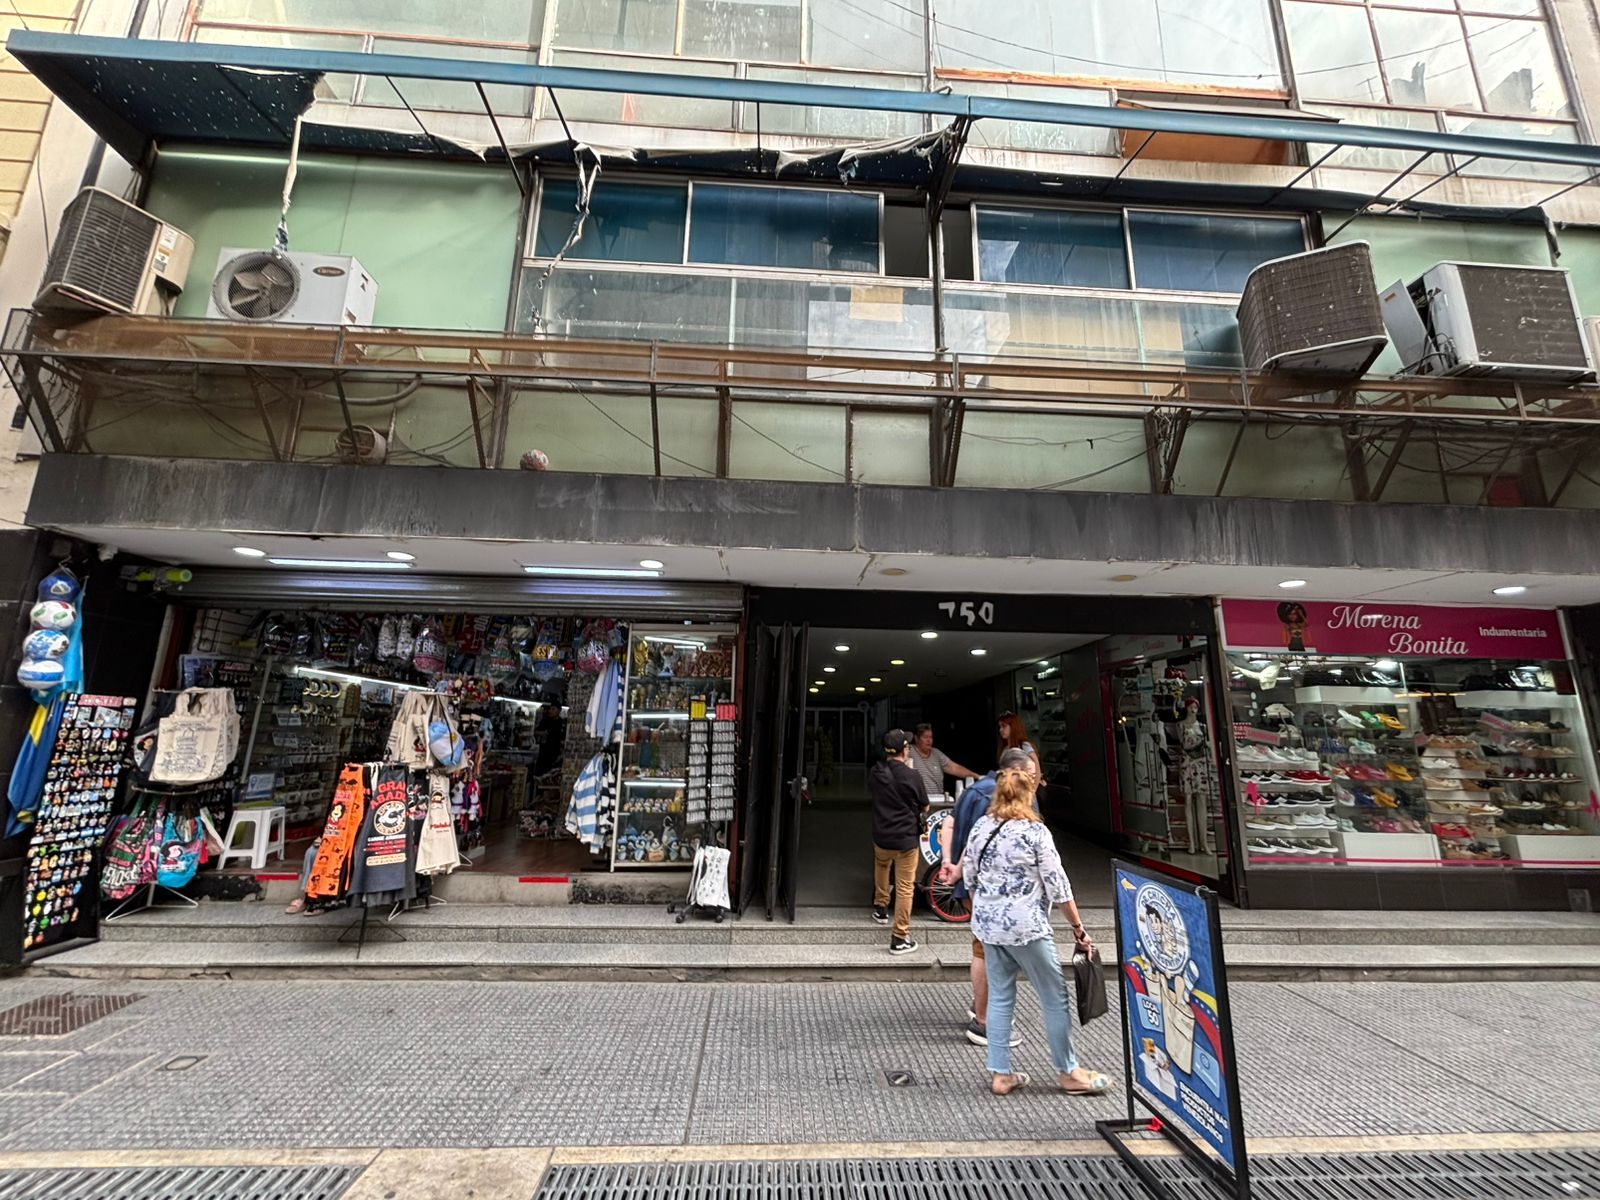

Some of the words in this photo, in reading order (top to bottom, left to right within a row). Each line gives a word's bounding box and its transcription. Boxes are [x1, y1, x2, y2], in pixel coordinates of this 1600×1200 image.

[938, 601, 994, 626] 750
[1327, 605, 1421, 630] Morena
[1387, 632, 1469, 655] Bonita
[1478, 626, 1548, 638] Indumentaria
[925, 850, 936, 862] EN
[1142, 999, 1159, 1013] LOCAL
[1147, 1009, 1159, 1026] 50
[1180, 1091, 1215, 1126] PRODUCTOS
[1181, 1100, 1223, 1143] VENEZOLANOS
